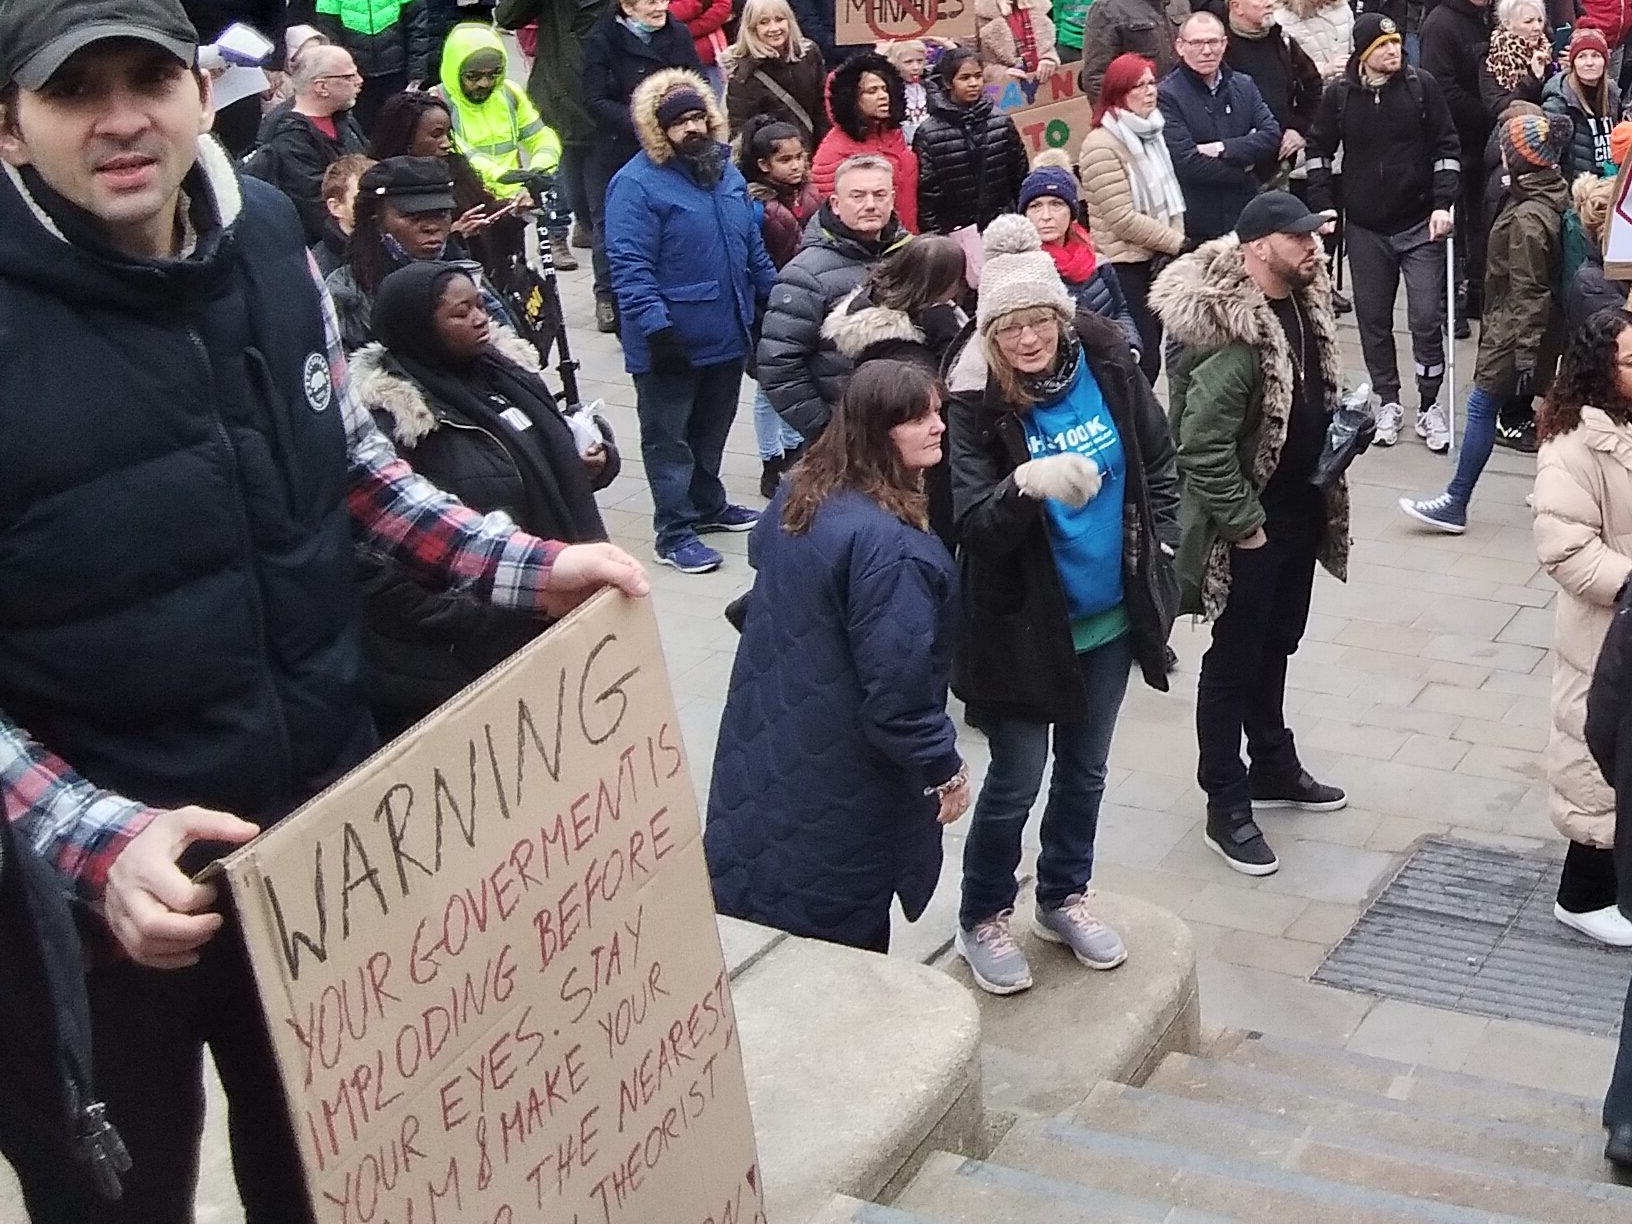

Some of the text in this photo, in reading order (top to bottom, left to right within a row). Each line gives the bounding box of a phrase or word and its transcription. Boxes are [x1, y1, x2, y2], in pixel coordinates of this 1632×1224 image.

[537, 226, 556, 276] PURE
[1022, 119, 1070, 152] TO
[263, 633, 641, 981] WARNING
[286, 723, 681, 1091] YOUR GOVERMENT IS
[306, 806, 674, 1171] IMPLODING BEFORE
[323, 1115, 428, 1224] YOUR
[440, 1005, 560, 1132] EYES.
[561, 905, 643, 1024] STAY
[476, 1115, 492, 1191] &
[500, 1043, 589, 1164] MAKE
[597, 961, 671, 1060] YOUR
[526, 1105, 601, 1211] THE
